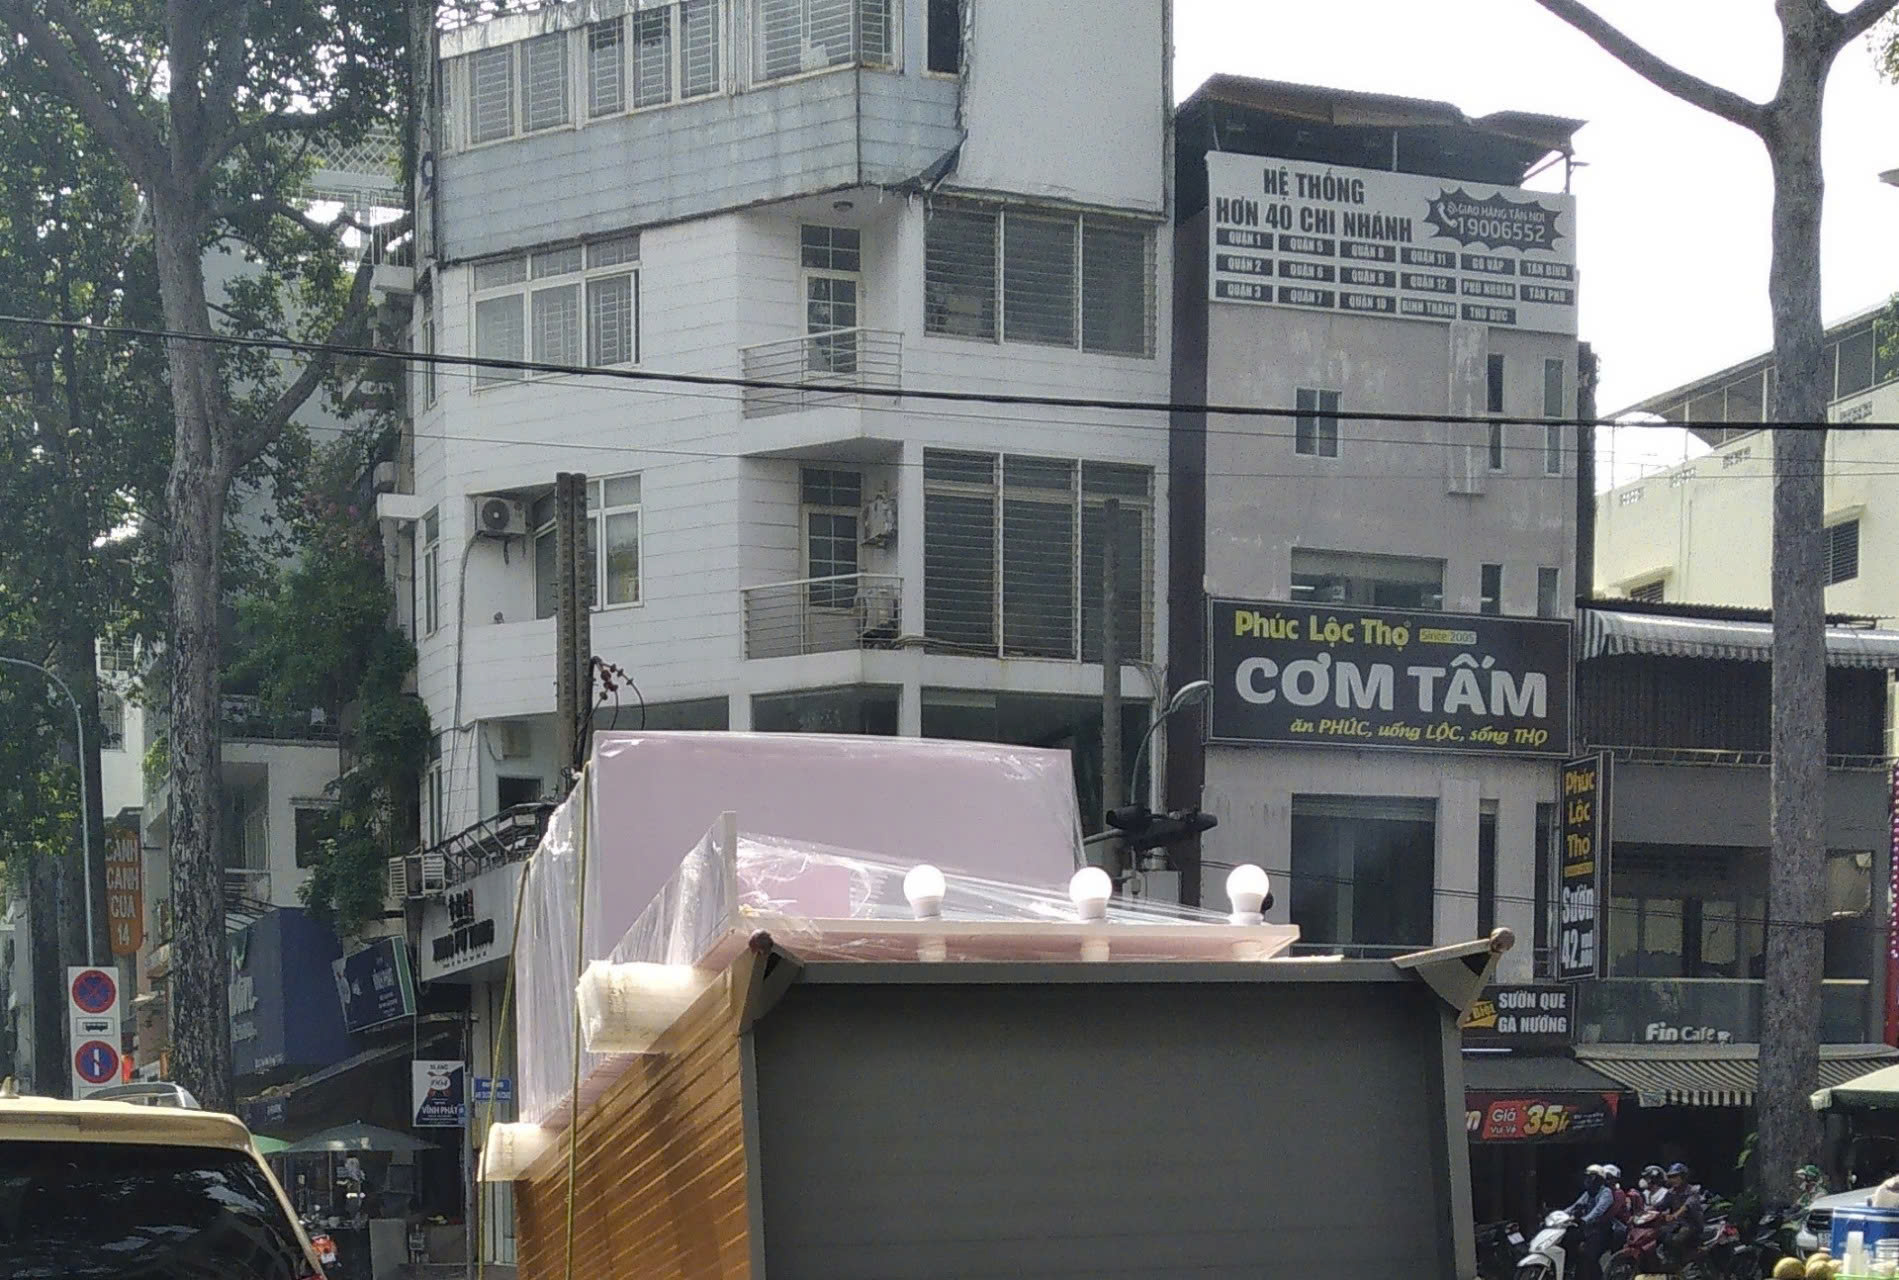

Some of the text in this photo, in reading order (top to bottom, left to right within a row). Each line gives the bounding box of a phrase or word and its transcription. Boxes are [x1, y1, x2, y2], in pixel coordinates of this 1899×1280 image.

[1295, 167, 1365, 205] THỐNG
[1216, 196, 1412, 243] HƠN 40 CHI NHÁNH
[1458, 217, 1546, 243] 19006552
[1235, 610, 1410, 652] Phúc Lộc Thọ
[1235, 651, 1548, 718] CƠM TẤM
[1290, 718, 1314, 734] ăn
[1318, 717, 1372, 738] PHÚC,
[1378, 722, 1421, 741] uống
[1425, 722, 1465, 743] LỘC,
[1469, 724, 1509, 745] sống
[1567, 800, 1591, 828] Lộc
[1498, 990, 1566, 1010] SƯỜN QUE
[1498, 1015, 1567, 1033] GÀ NƯỚNG
[1645, 1021, 1679, 1041] Fin
